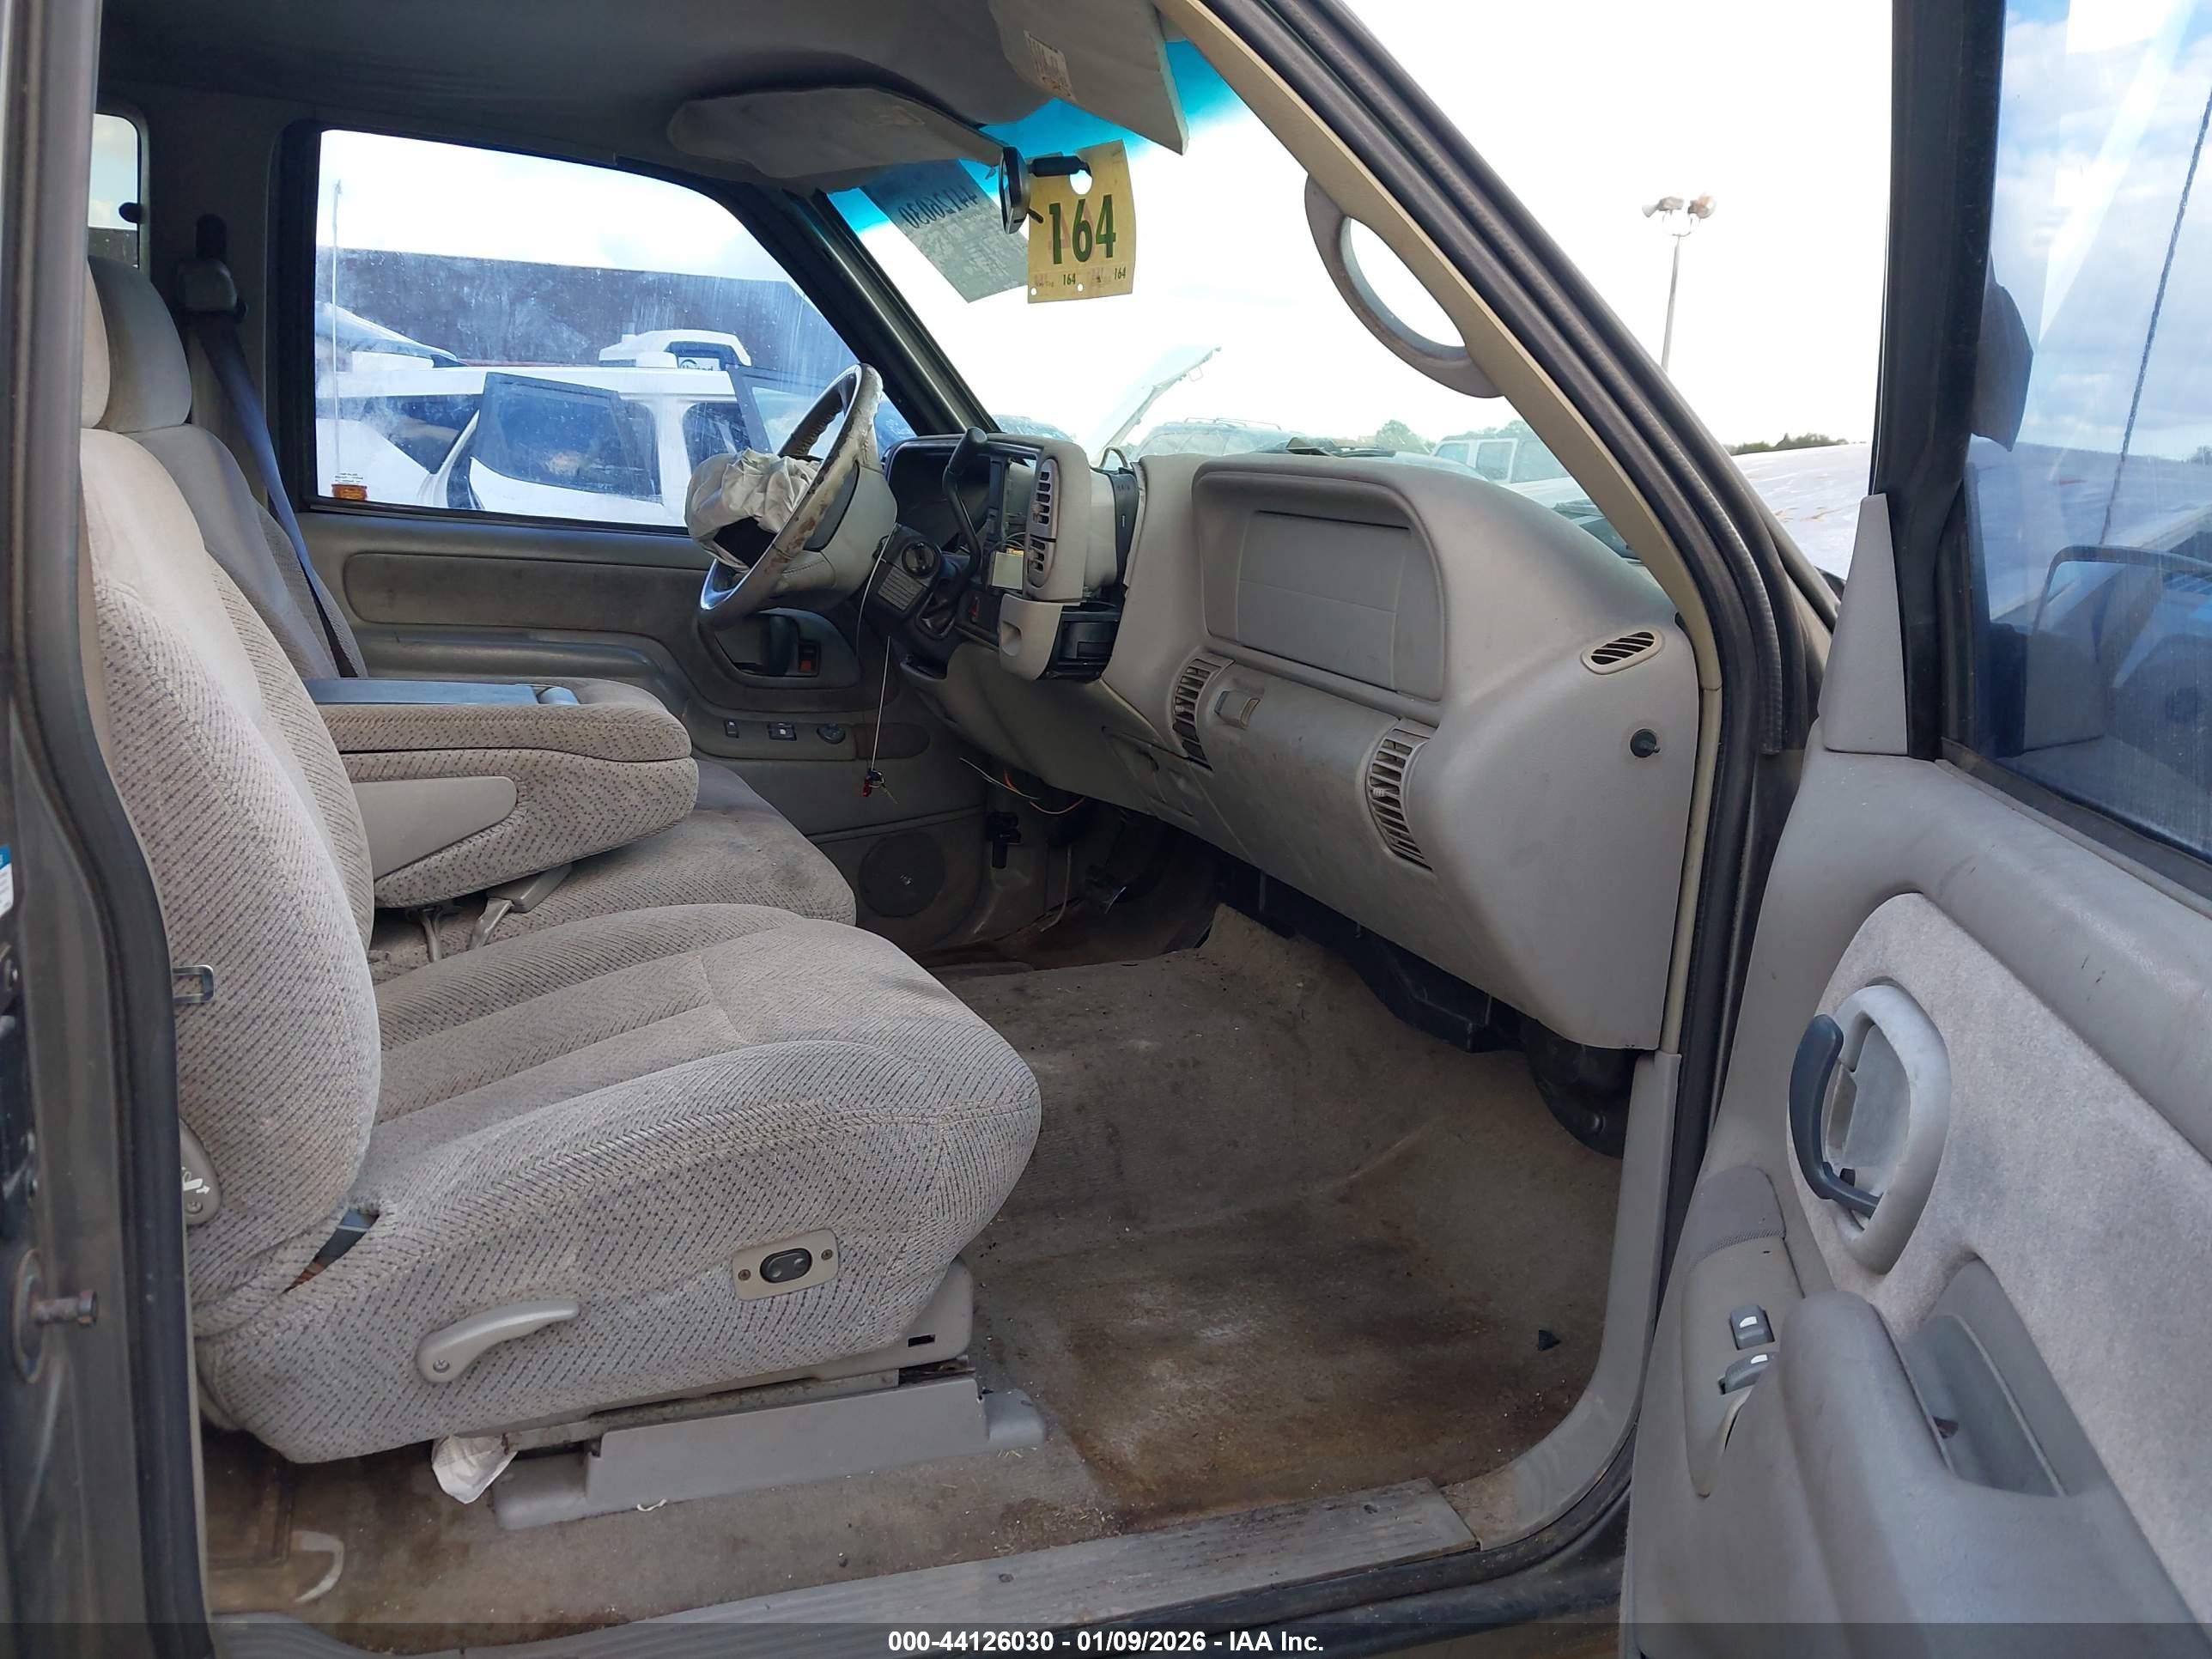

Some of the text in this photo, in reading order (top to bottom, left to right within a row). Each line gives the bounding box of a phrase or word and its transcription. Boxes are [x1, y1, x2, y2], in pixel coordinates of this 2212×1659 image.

[1048, 194, 1116, 264] 164
[1063, 273, 1076, 285] 164
[1114, 266, 1127, 280] 164
